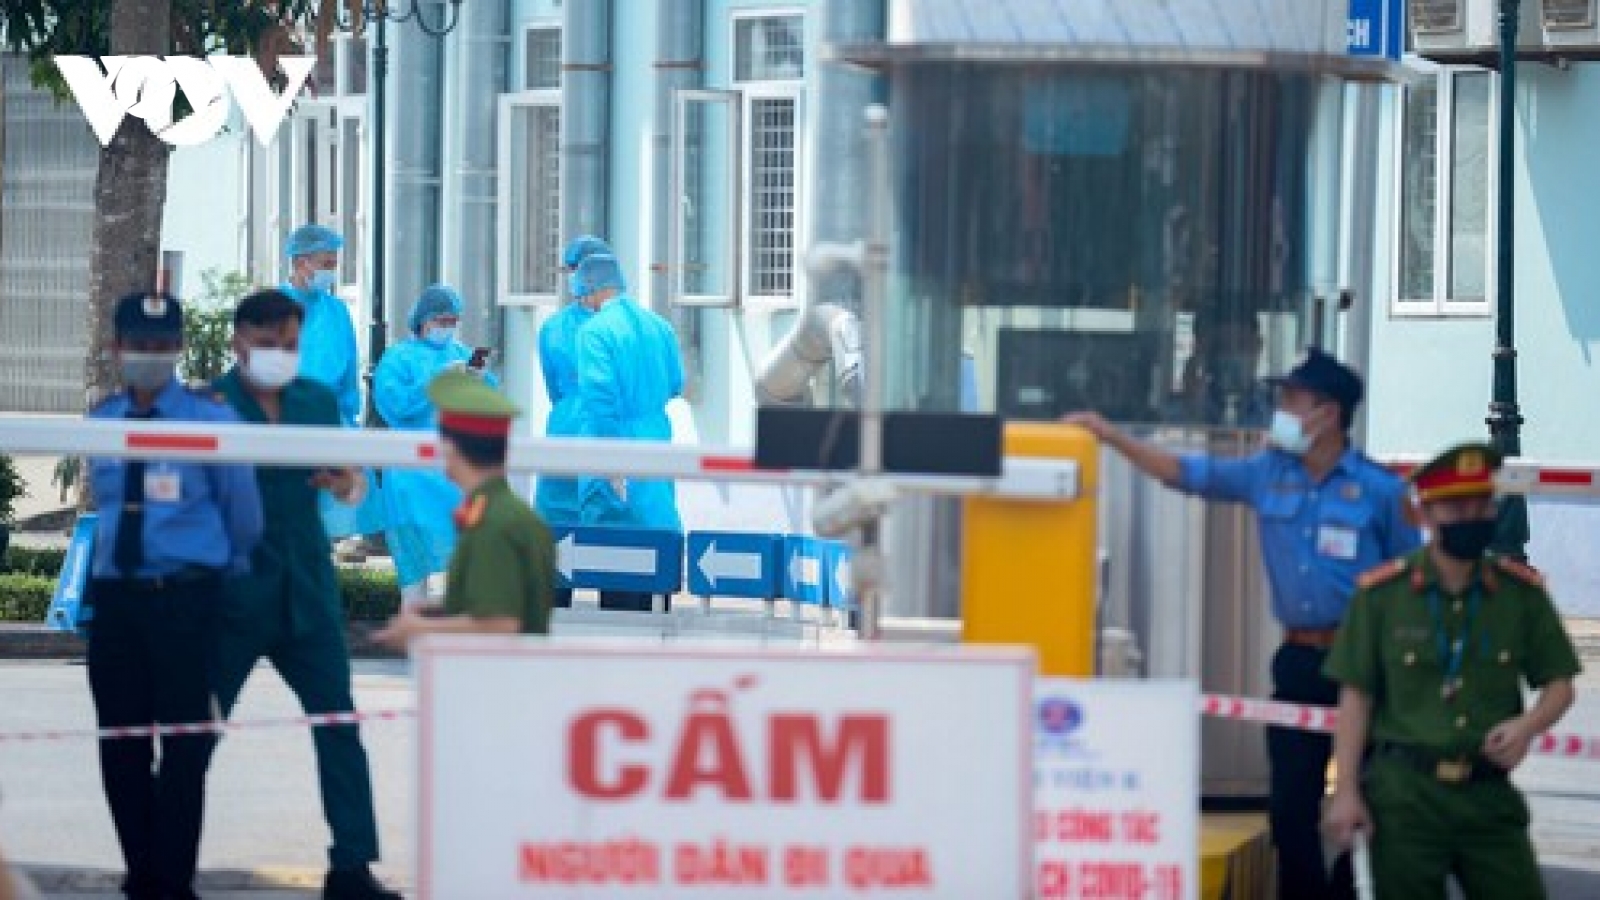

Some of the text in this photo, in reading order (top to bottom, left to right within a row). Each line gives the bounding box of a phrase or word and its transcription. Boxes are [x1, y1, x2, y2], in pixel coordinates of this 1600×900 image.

[565, 676, 893, 804] CẤM
[518, 834, 659, 884] NGƯỜI
[844, 846, 932, 890] QUA
